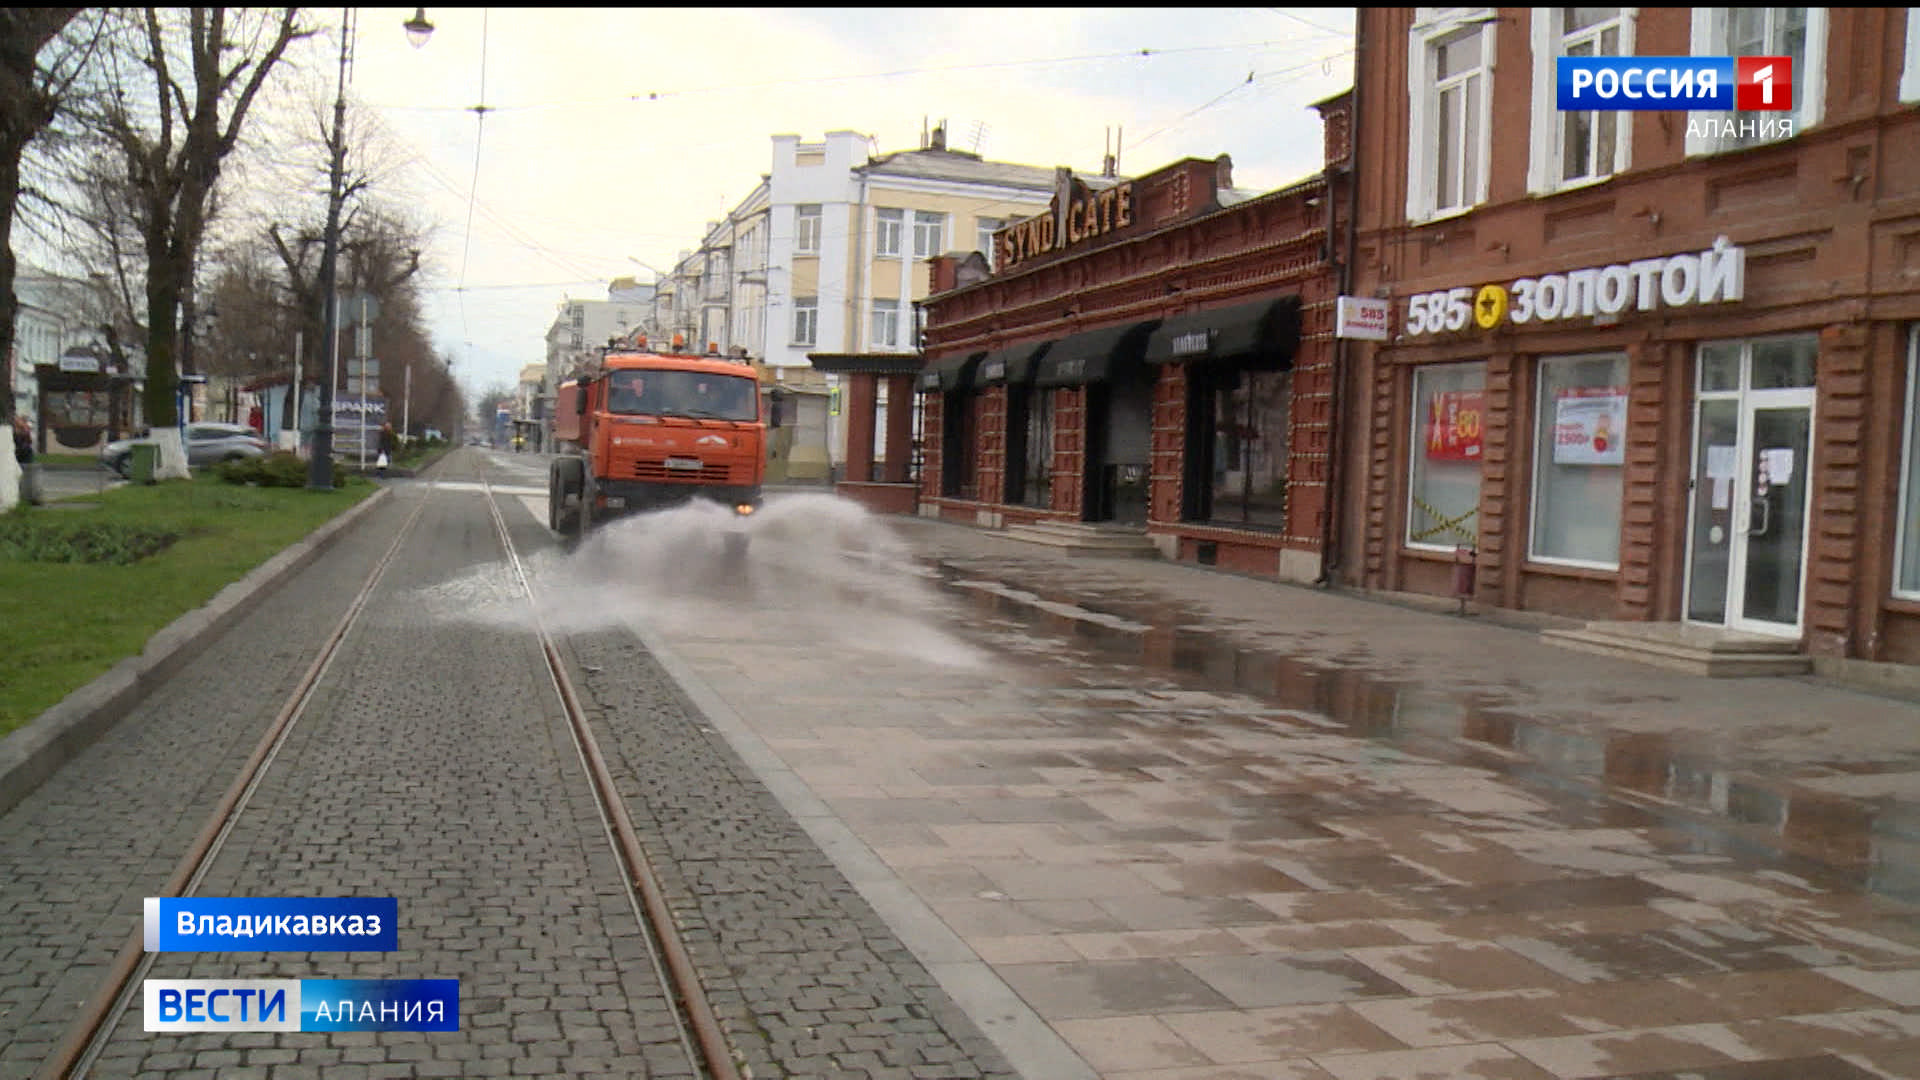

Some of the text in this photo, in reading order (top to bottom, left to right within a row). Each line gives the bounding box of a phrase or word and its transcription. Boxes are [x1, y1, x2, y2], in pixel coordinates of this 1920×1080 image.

[1004, 168, 1132, 266] SYNDICATE
[1360, 306, 1385, 320] 585
[1407, 234, 1745, 336] 585 ЗОЛОТОЙ
